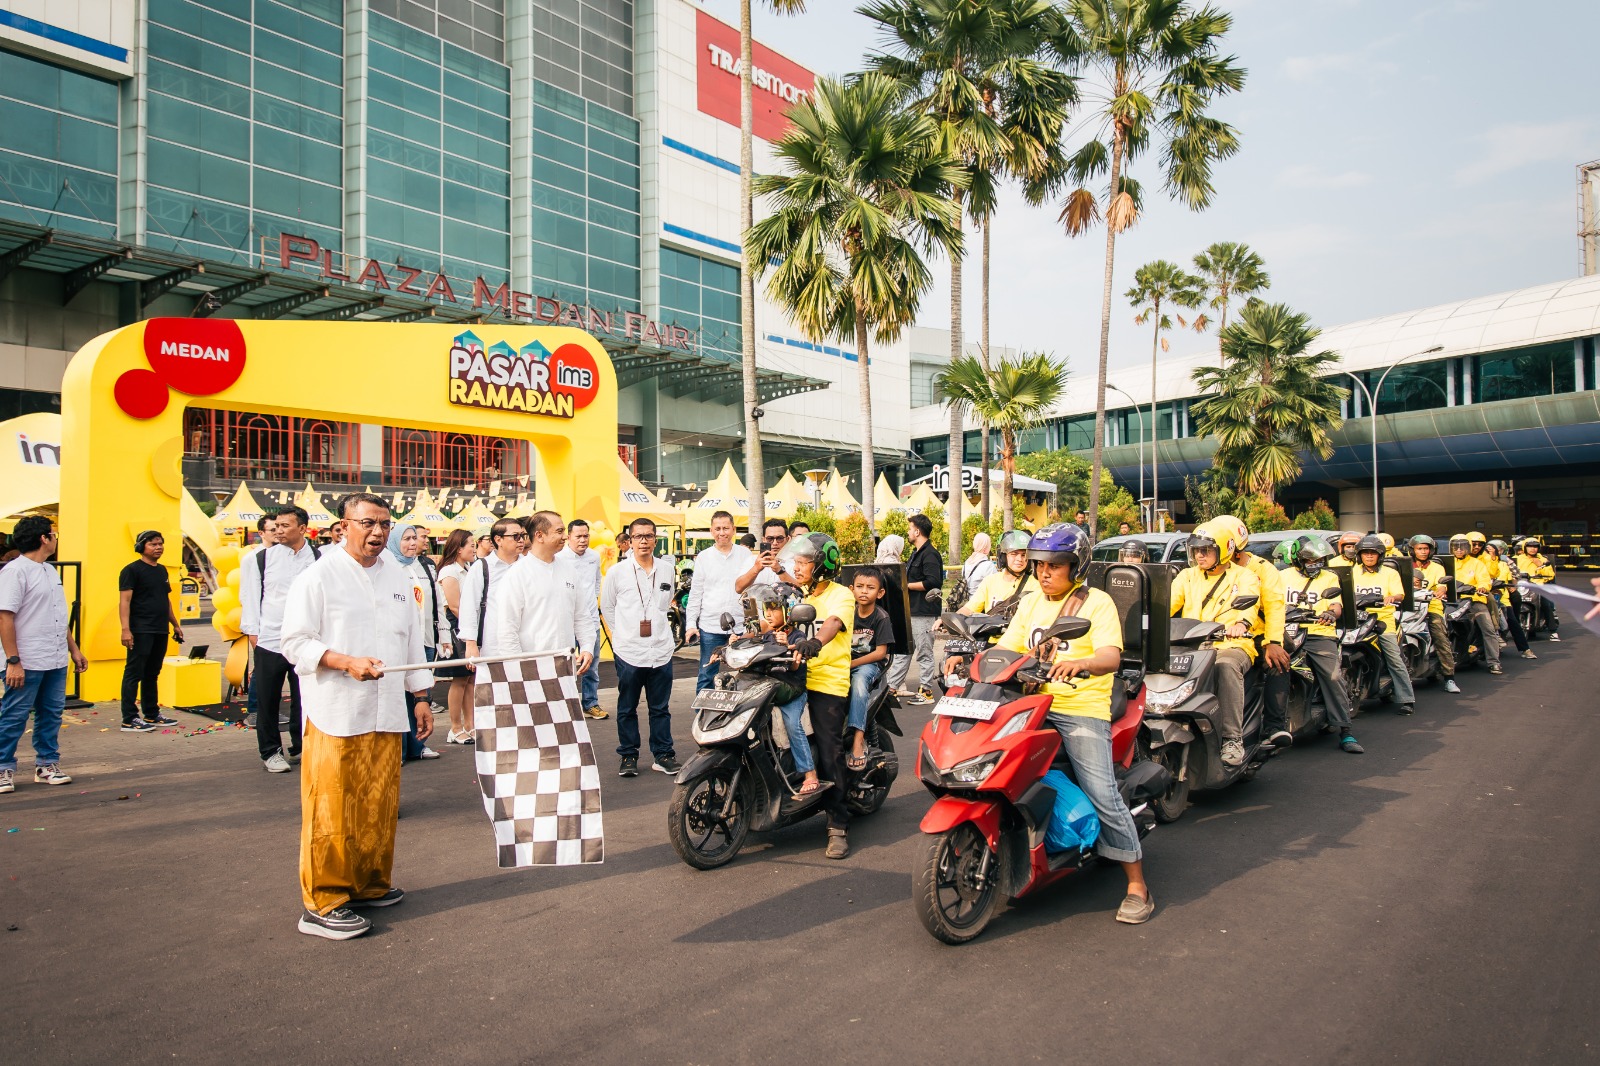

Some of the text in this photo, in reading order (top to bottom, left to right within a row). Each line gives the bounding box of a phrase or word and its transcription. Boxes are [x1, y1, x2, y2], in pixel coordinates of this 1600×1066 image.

[279, 232, 457, 303] PLAZA
[160, 340, 230, 362] MEDAN
[450, 349, 549, 392] PASAR
[557, 360, 593, 389] im3
[450, 378, 574, 418] RAMADAN
[19, 434, 60, 464] im
[622, 489, 650, 503] im3
[1111, 577, 1135, 586] Karta
